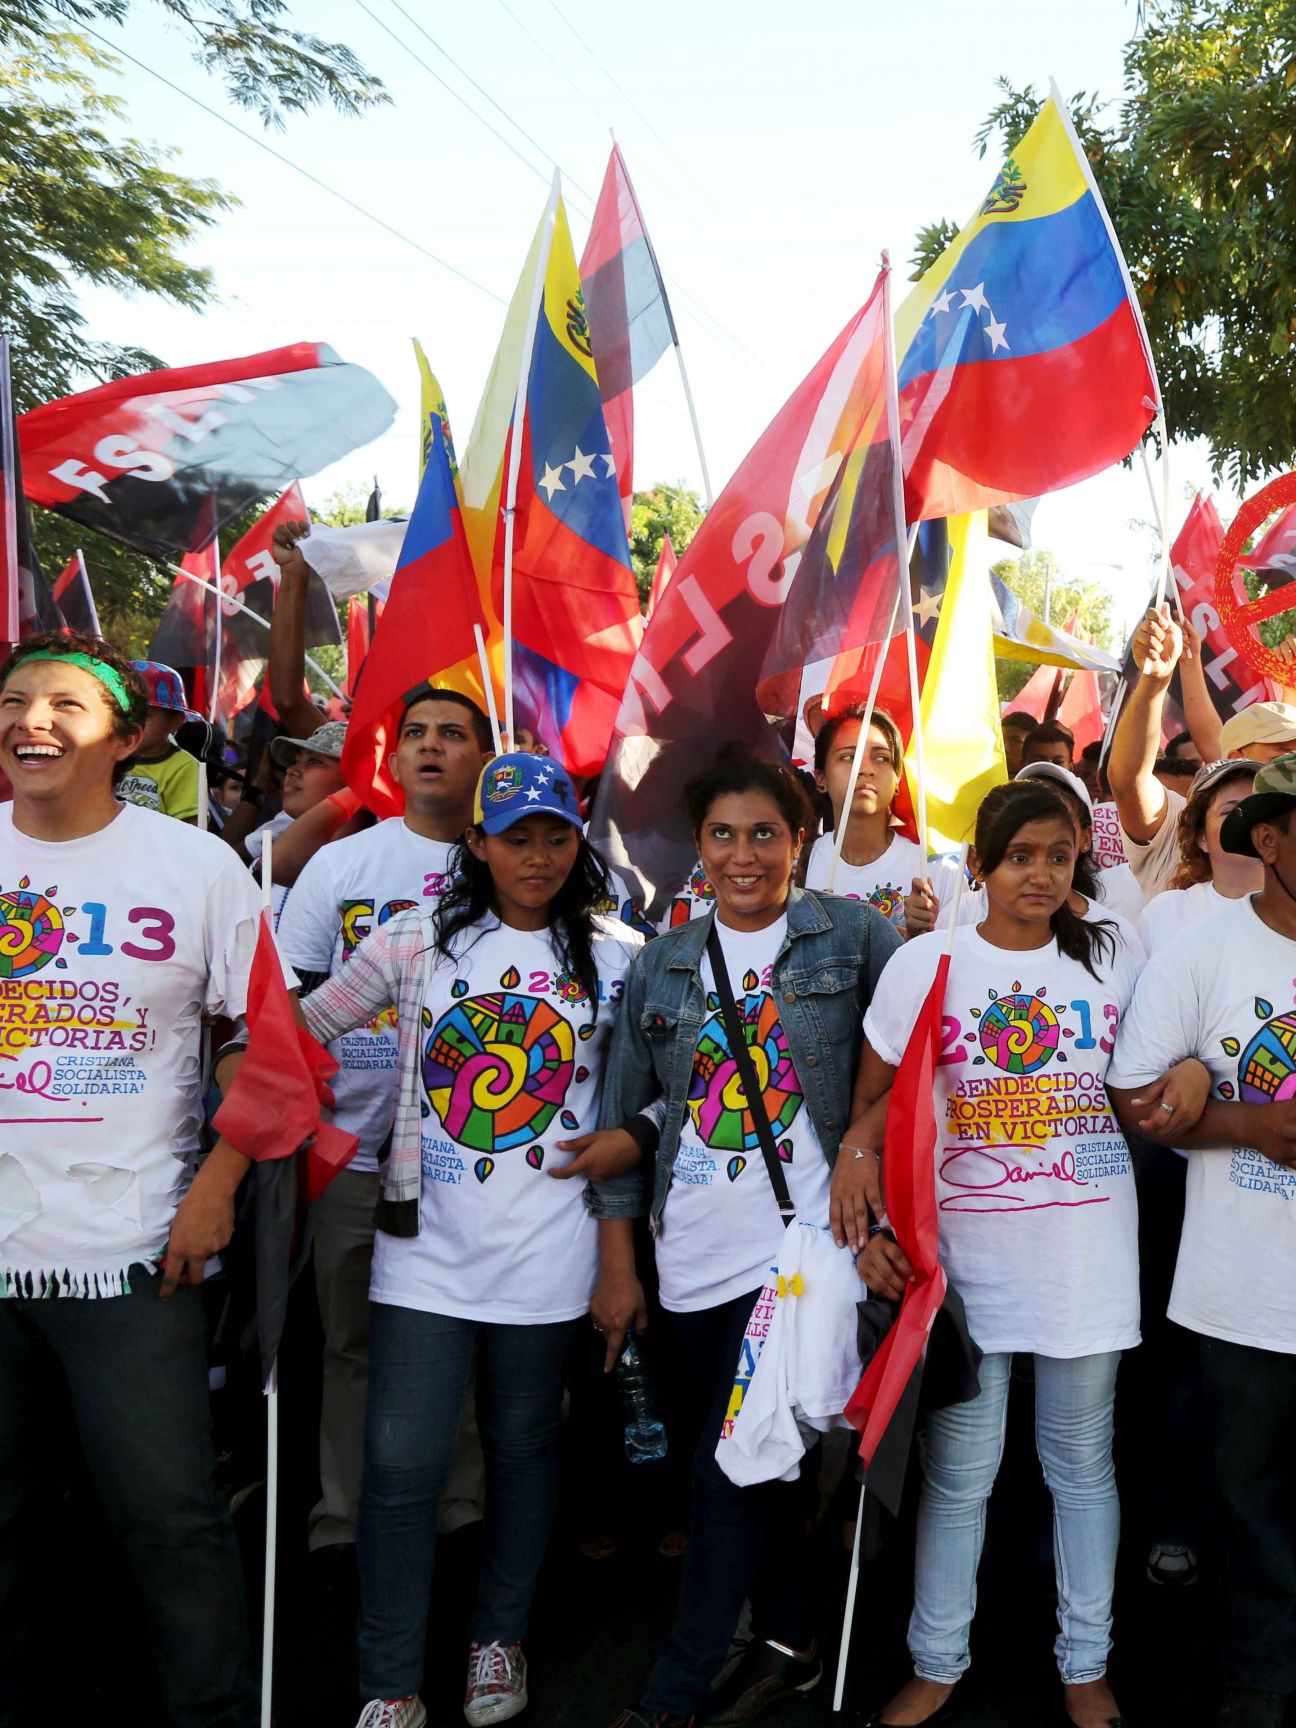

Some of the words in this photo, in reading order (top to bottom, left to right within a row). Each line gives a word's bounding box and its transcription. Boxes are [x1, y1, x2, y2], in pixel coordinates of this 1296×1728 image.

[0, 980, 132, 1007] ECIDOS,
[0, 1003, 116, 1027] ERADOS
[136, 1008, 149, 1028] Y
[0, 1026, 156, 1051] CTORIAS!
[51, 1083, 144, 1095] SOLIDARIA!
[957, 1122, 991, 1141] EN
